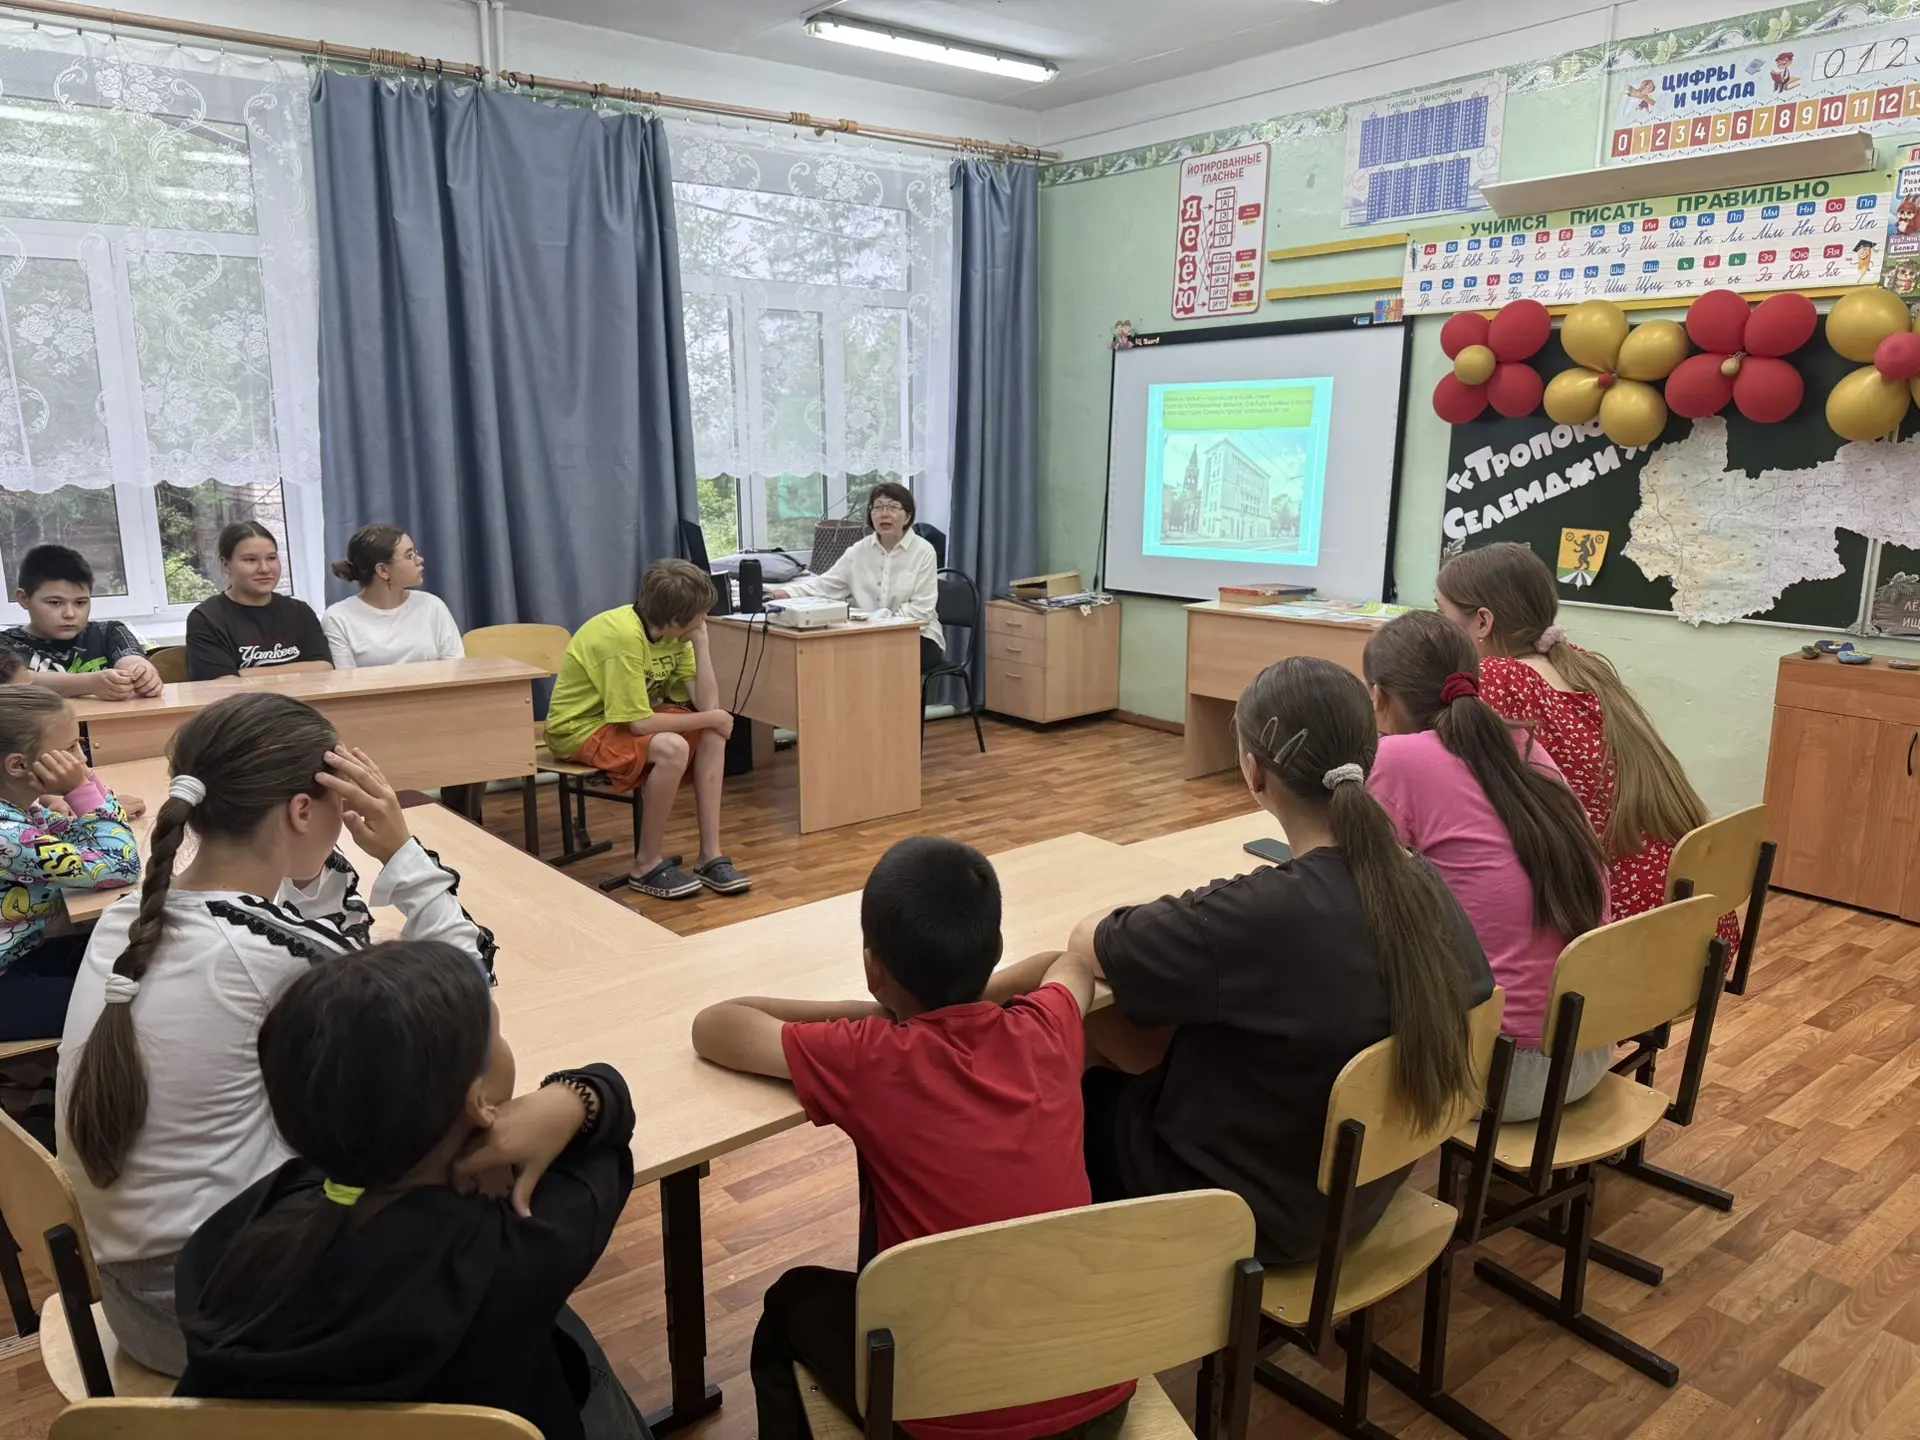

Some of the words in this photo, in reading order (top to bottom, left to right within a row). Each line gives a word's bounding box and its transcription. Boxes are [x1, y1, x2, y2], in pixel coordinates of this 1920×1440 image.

[1824, 48, 1845, 78] 0
[1856, 42, 1878, 74] 1
[1884, 38, 1908, 69] 2
[1662, 64, 1736, 92] ЦИФРЫ
[1674, 92, 1686, 108] И
[1690, 81, 1756, 105] ЧИСЛА
[1618, 134, 1628, 152] 0
[1640, 132, 1645, 148] 1
[1656, 128, 1666, 146] 2
[1676, 125, 1686, 143] 3
[1694, 122, 1706, 140] 4
[1716, 119, 1726, 137] 5
[1736, 116, 1748, 134] 6
[1759, 112, 1770, 132] 7
[1779, 109, 1790, 128] 8
[1801, 106, 1813, 125] 9
[1822, 101, 1842, 122] 10
[1852, 97, 1868, 118] 11
[1878, 92, 1899, 114] 12
[1187, 152, 1262, 176] ЙОТИРОВАННЫЕ
[1202, 167, 1244, 184] ГЛАСНЫЕ
[1184, 200, 1198, 219] Я
[1470, 214, 1547, 236] УЧИМСЯ
[1570, 202, 1654, 225] ПИСАТЬ
[1676, 180, 1830, 212] ПРАВИЛЬНО
[238, 643, 300, 668] Yankees
